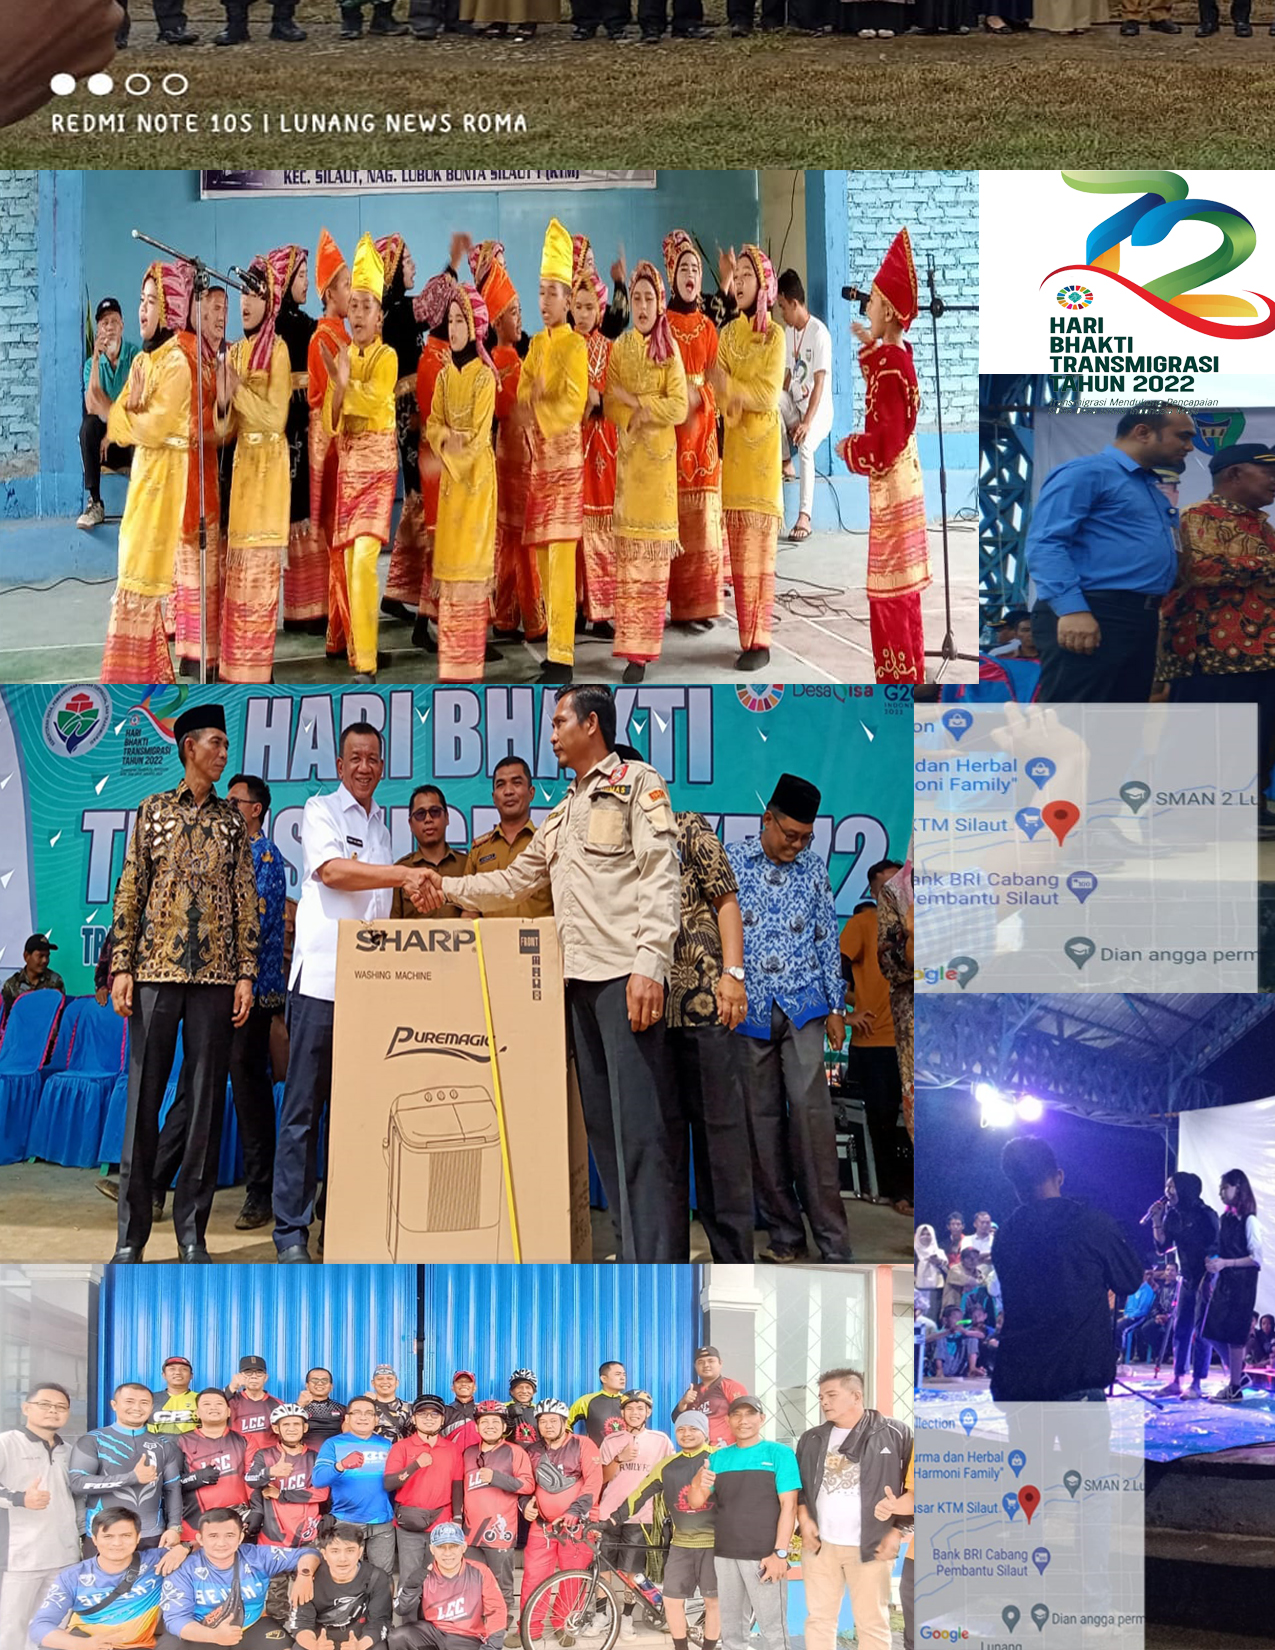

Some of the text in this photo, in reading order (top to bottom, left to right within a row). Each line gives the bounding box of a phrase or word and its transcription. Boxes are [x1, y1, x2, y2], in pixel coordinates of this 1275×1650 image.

[283, 170, 311, 184] KEC.
[315, 170, 363, 185] SILAUT,
[367, 170, 397, 182] NAG.
[126, 729, 142, 737] HARI
[124, 737, 149, 746] BHAKTI
[123, 746, 172, 756] TRANSMIGRASI
[122, 756, 164, 765] TAHUN 2022
[356, 928, 477, 952] SHARP
[520, 935, 540, 947] FRONT
[354, 970, 432, 981] WASHING MACHINE
[241, 1416, 266, 1432] LCC
[280, 1473, 305, 1492] LCC
[436, 1598, 465, 1619] LCC
